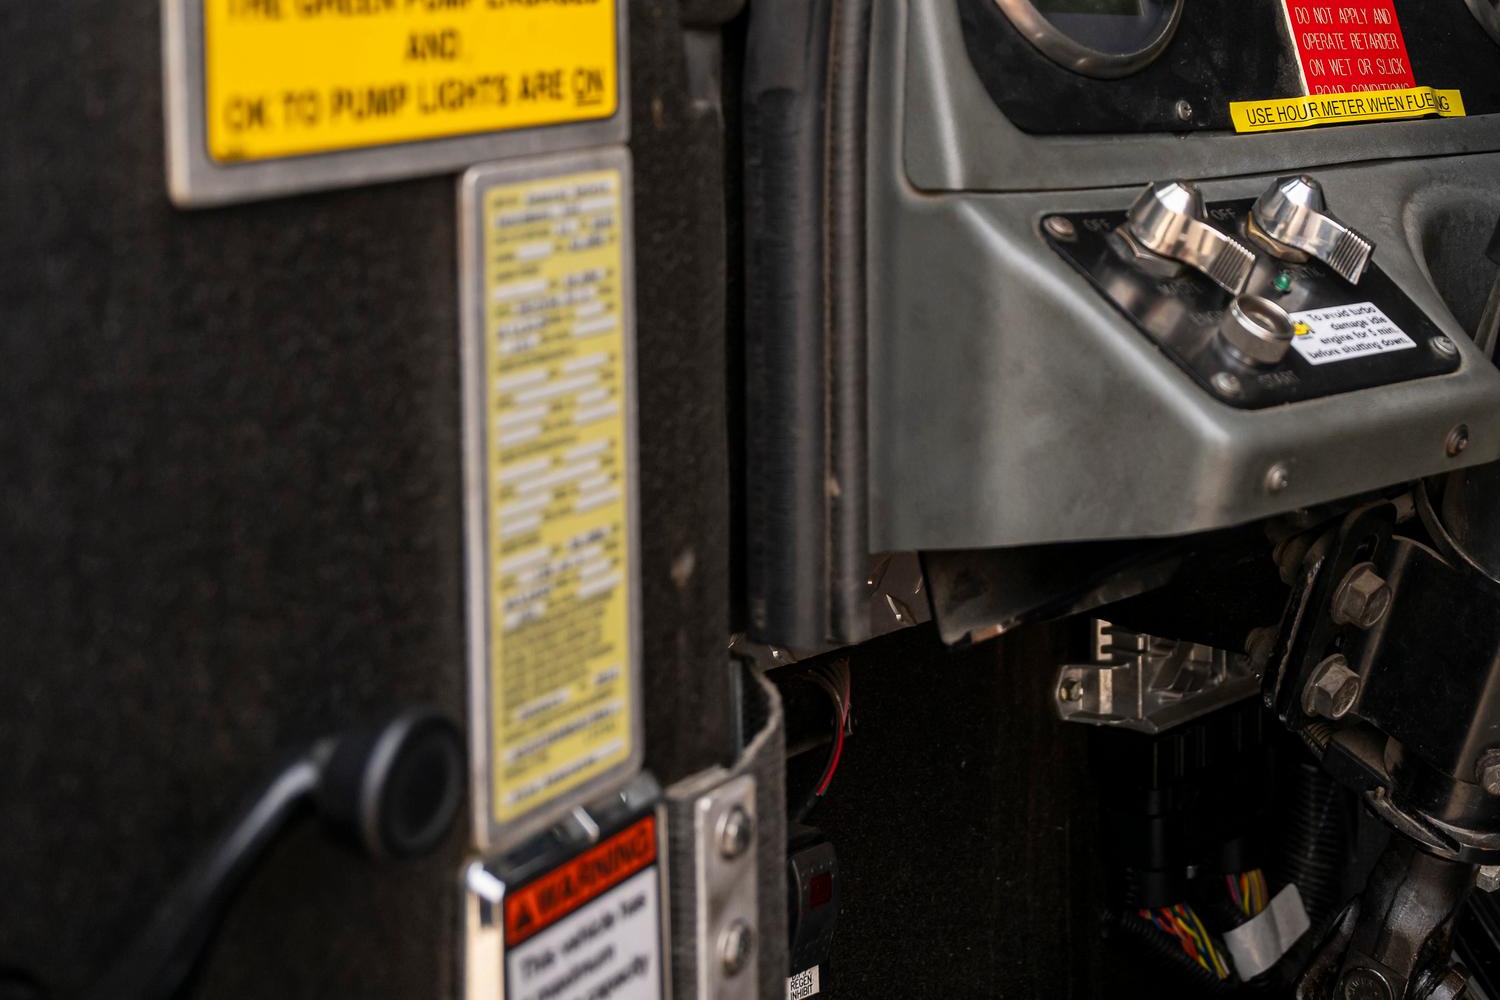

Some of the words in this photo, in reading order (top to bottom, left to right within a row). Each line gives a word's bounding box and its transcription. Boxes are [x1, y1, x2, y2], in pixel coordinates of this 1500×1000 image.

[1294, 6, 1310, 24] DO
[1312, 7, 1334, 24] NOT
[1338, 8, 1368, 24] APPLY
[1372, 8, 1392, 24] AND
[404, 28, 460, 63] AND
[1302, 32, 1348, 50] OPERATE
[1350, 32, 1400, 50] RETARDER
[1309, 58, 1326, 76] ON
[1328, 58, 1352, 76] WET
[1358, 58, 1374, 76] OR
[1376, 58, 1406, 75] SLICK
[224, 96, 268, 134] OK
[282, 89, 319, 127] TO
[329, 83, 408, 123] PUMP
[417, 74, 508, 116] LIGHTS
[518, 68, 563, 104] ARE
[573, 65, 604, 101] ON
[1246, 107, 1275, 125] USE
[1278, 102, 1320, 122] HOUR
[1321, 100, 1365, 118] METER
[1368, 96, 1404, 113] WHEN
